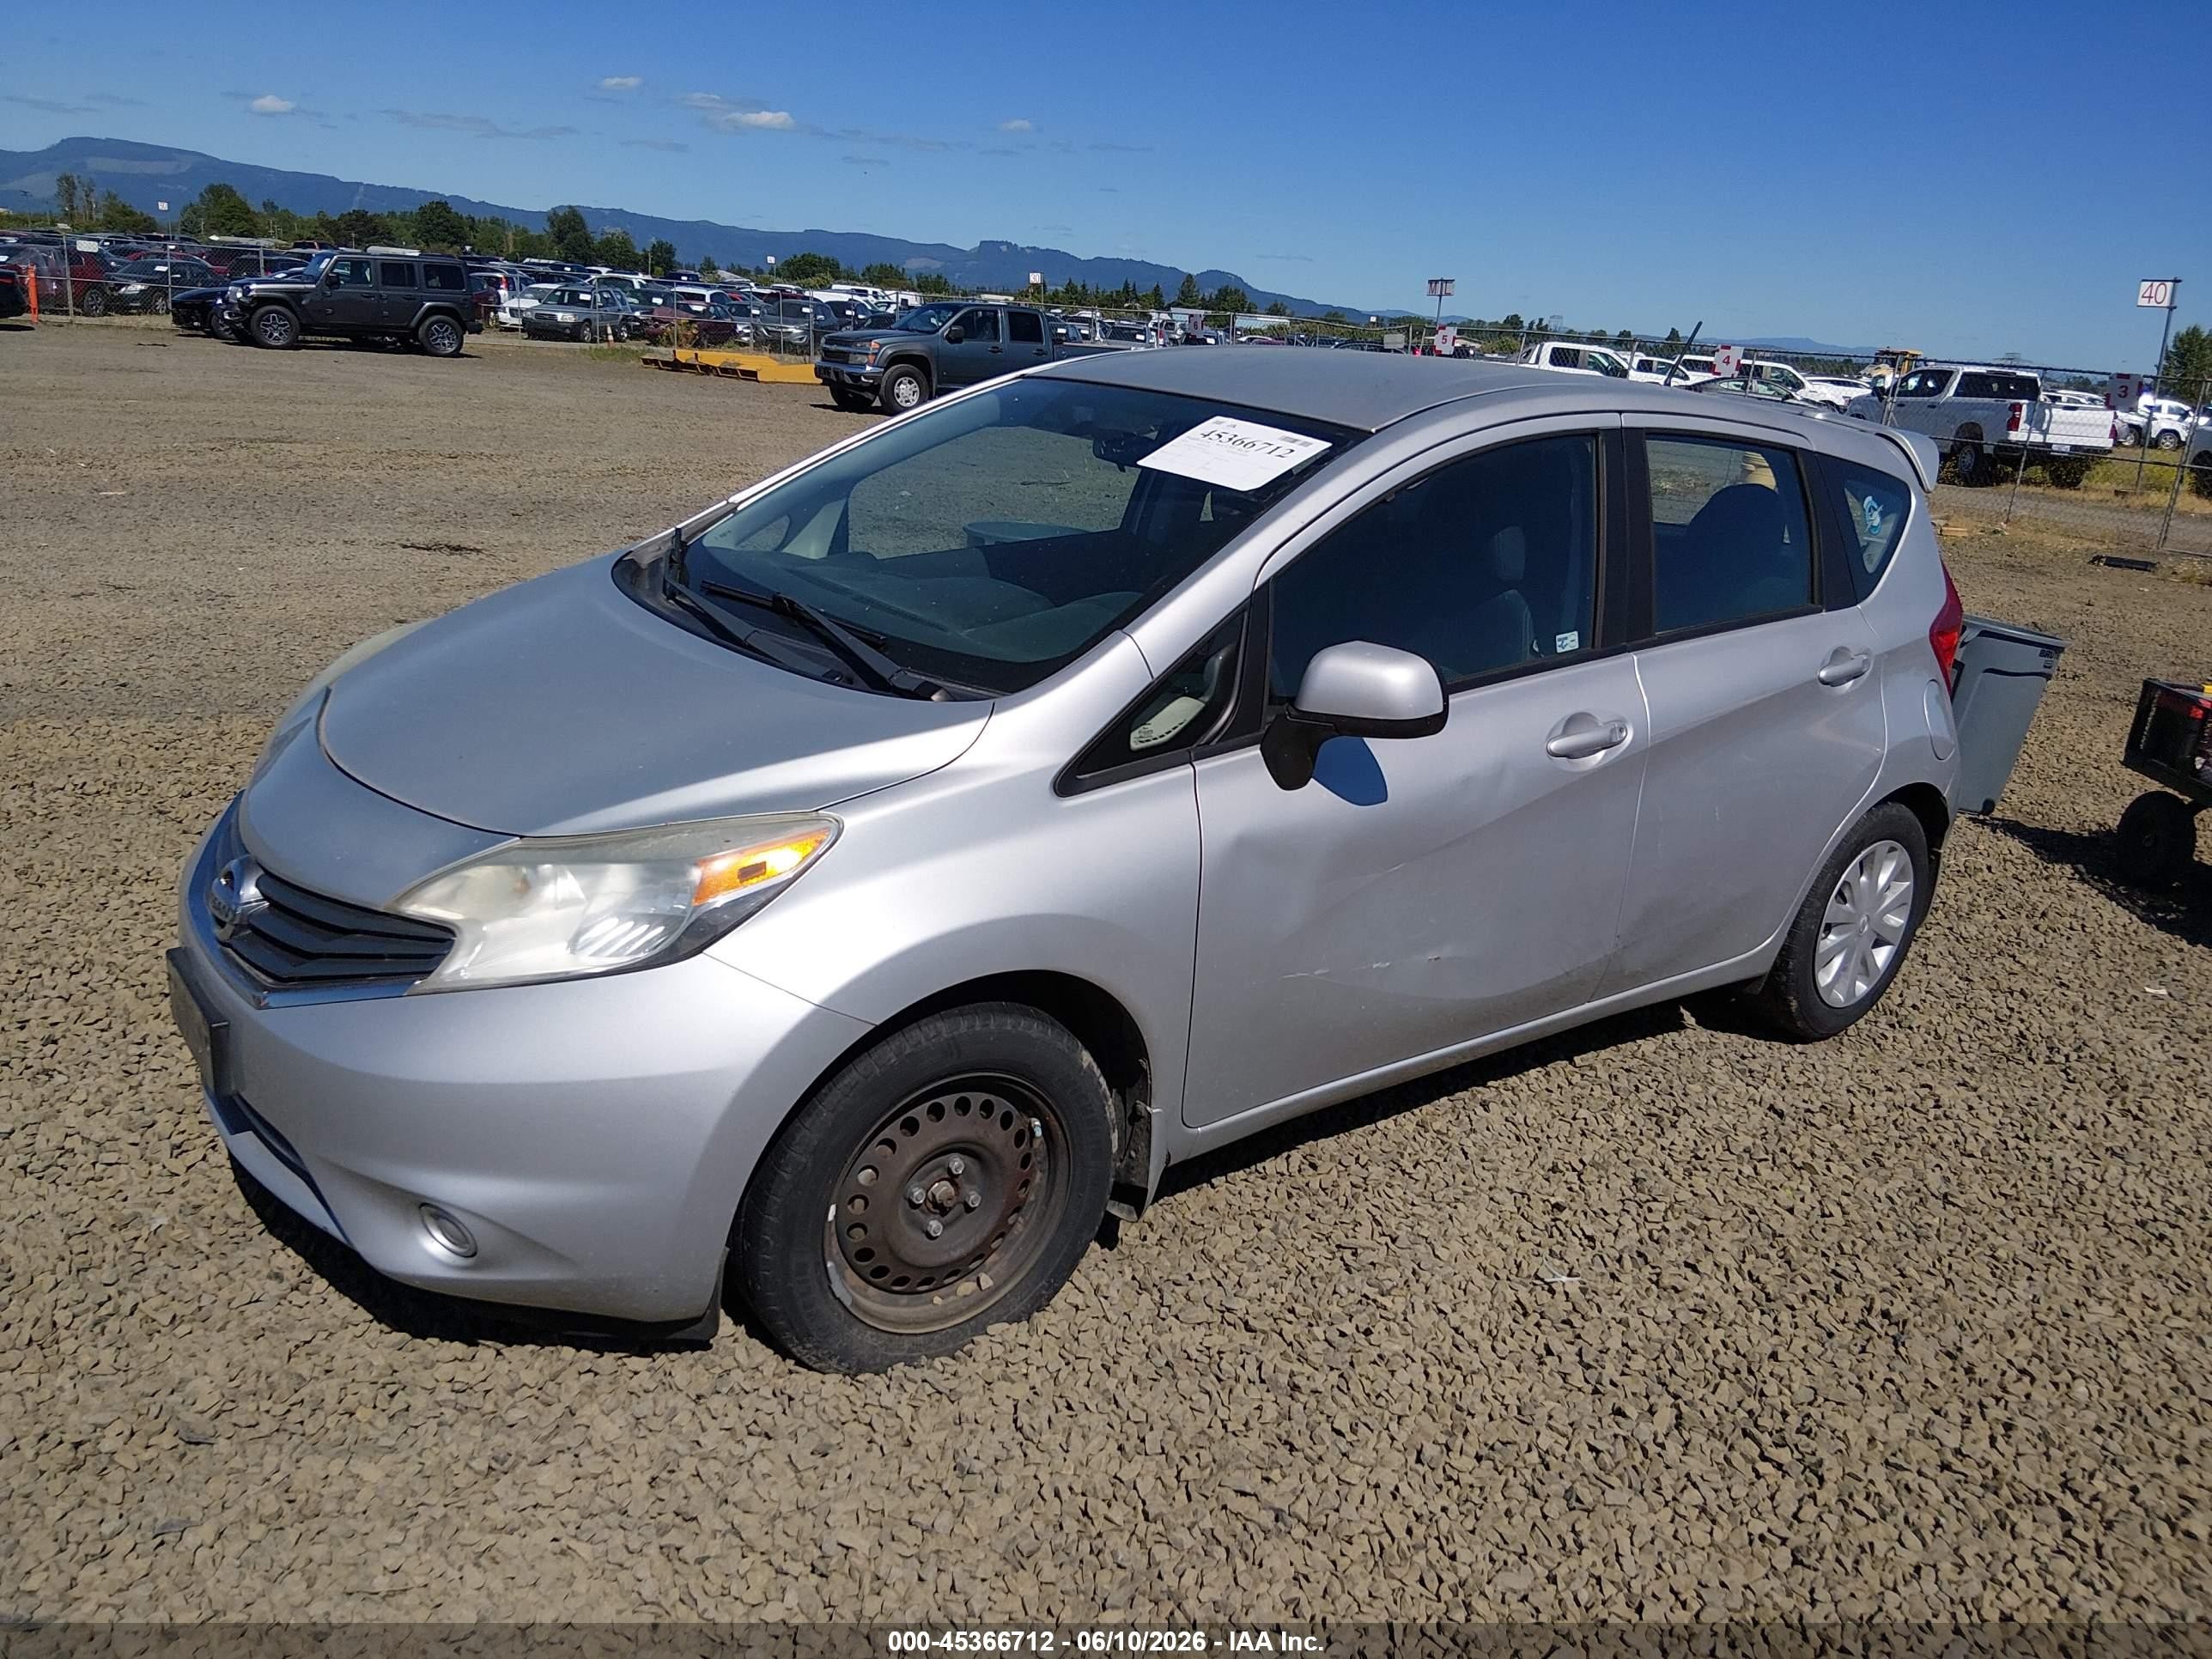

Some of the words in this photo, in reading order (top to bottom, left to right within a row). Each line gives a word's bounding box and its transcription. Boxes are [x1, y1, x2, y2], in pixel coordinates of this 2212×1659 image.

[1030, 274, 1040, 283] 30
[2141, 283, 2168, 305] 40
[1194, 322, 1198, 331] 6
[1441, 335, 1448, 344] 5
[1722, 355, 1730, 366] 4
[2118, 386, 2129, 398] 3
[1200, 429, 1296, 459] 45366712
